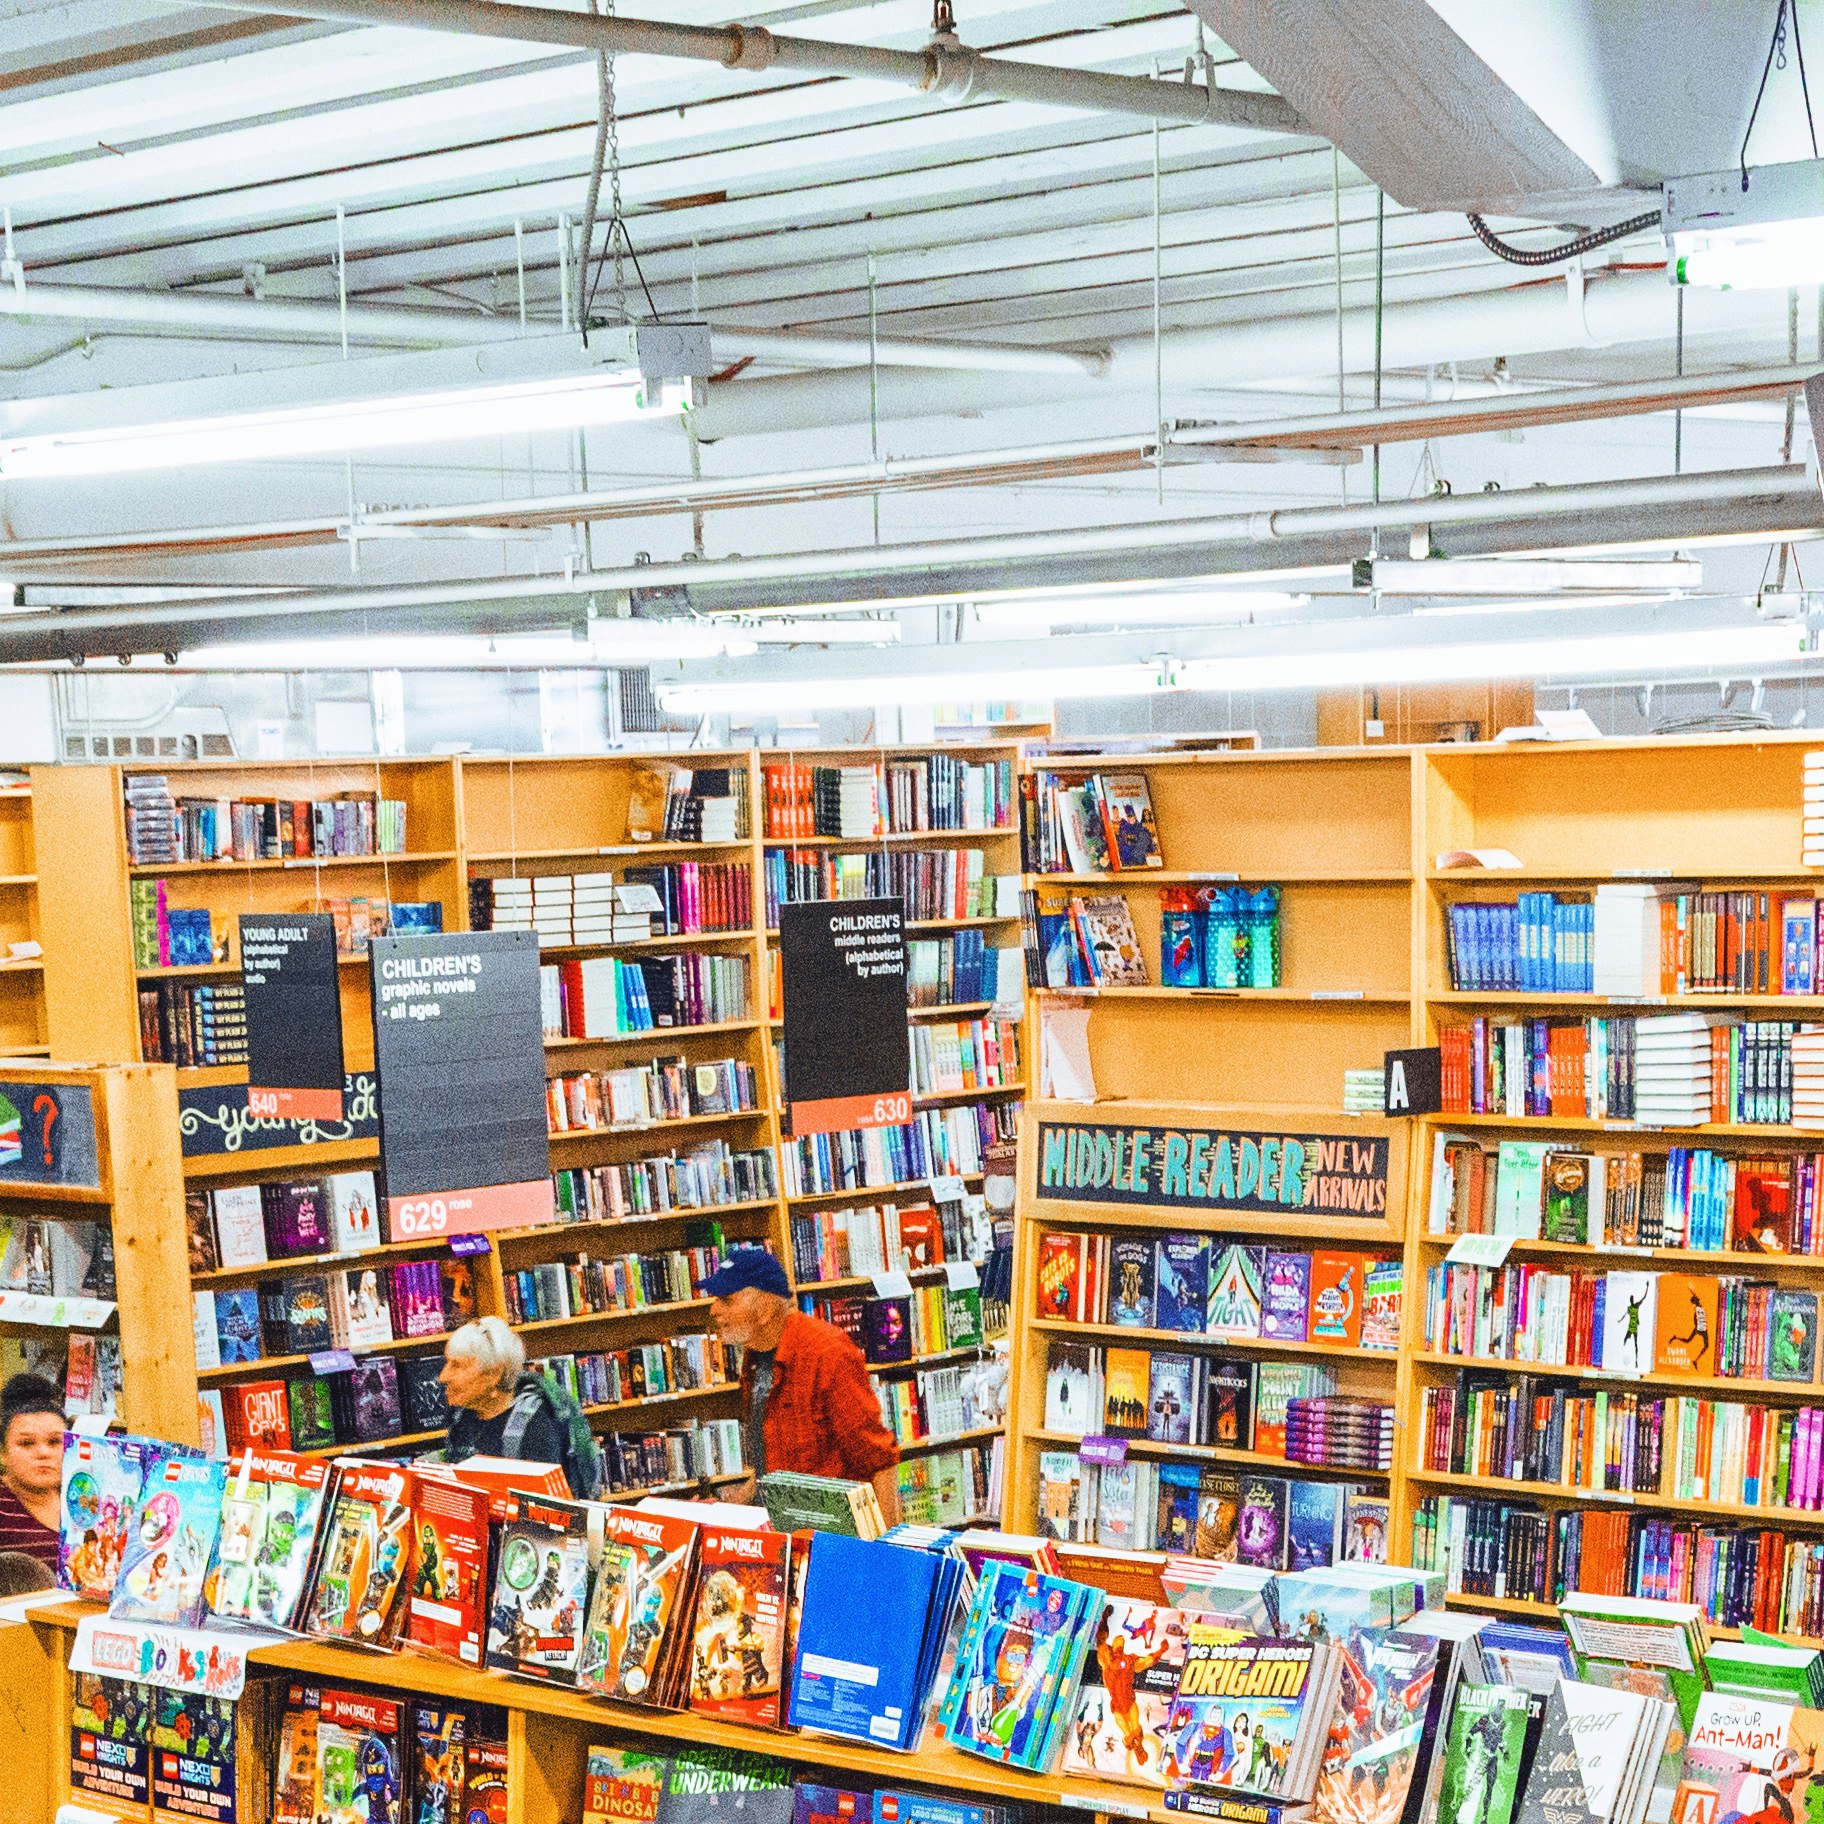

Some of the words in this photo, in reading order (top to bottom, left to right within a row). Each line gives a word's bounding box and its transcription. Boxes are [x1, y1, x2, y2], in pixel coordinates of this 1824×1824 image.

[830, 914, 900, 931] CHILDREN'S
[243, 928, 276, 941] YOUNG
[278, 928, 307, 940] ADULT
[835, 935, 864, 946] middle
[867, 934, 900, 944] readers
[382, 955, 482, 978] CHILDREN'S
[846, 949, 903, 966] (alphabetical
[871, 963, 903, 975] author)
[382, 980, 430, 1001] graphic
[434, 977, 475, 994] novels
[391, 1003, 406, 1019] all
[409, 1002, 440, 1020] ages
[1389, 1060, 1410, 1110] A
[248, 1093, 277, 1113] 640
[874, 1099, 907, 1122] 630
[1042, 1127, 1151, 1193] MIDDLE
[1162, 1131, 1306, 1205] READER
[1317, 1140, 1375, 1174] NEW
[1304, 1176, 1386, 1213] ARRIVALS
[400, 1200, 446, 1233] 629
[449, 1198, 472, 1210] rose
[1181, 1661, 1307, 1700] ORIGAMI
[1694, 1724, 1781, 1750] Ant-Man!
[1221, 1802, 1268, 1823] ORIGAMI
